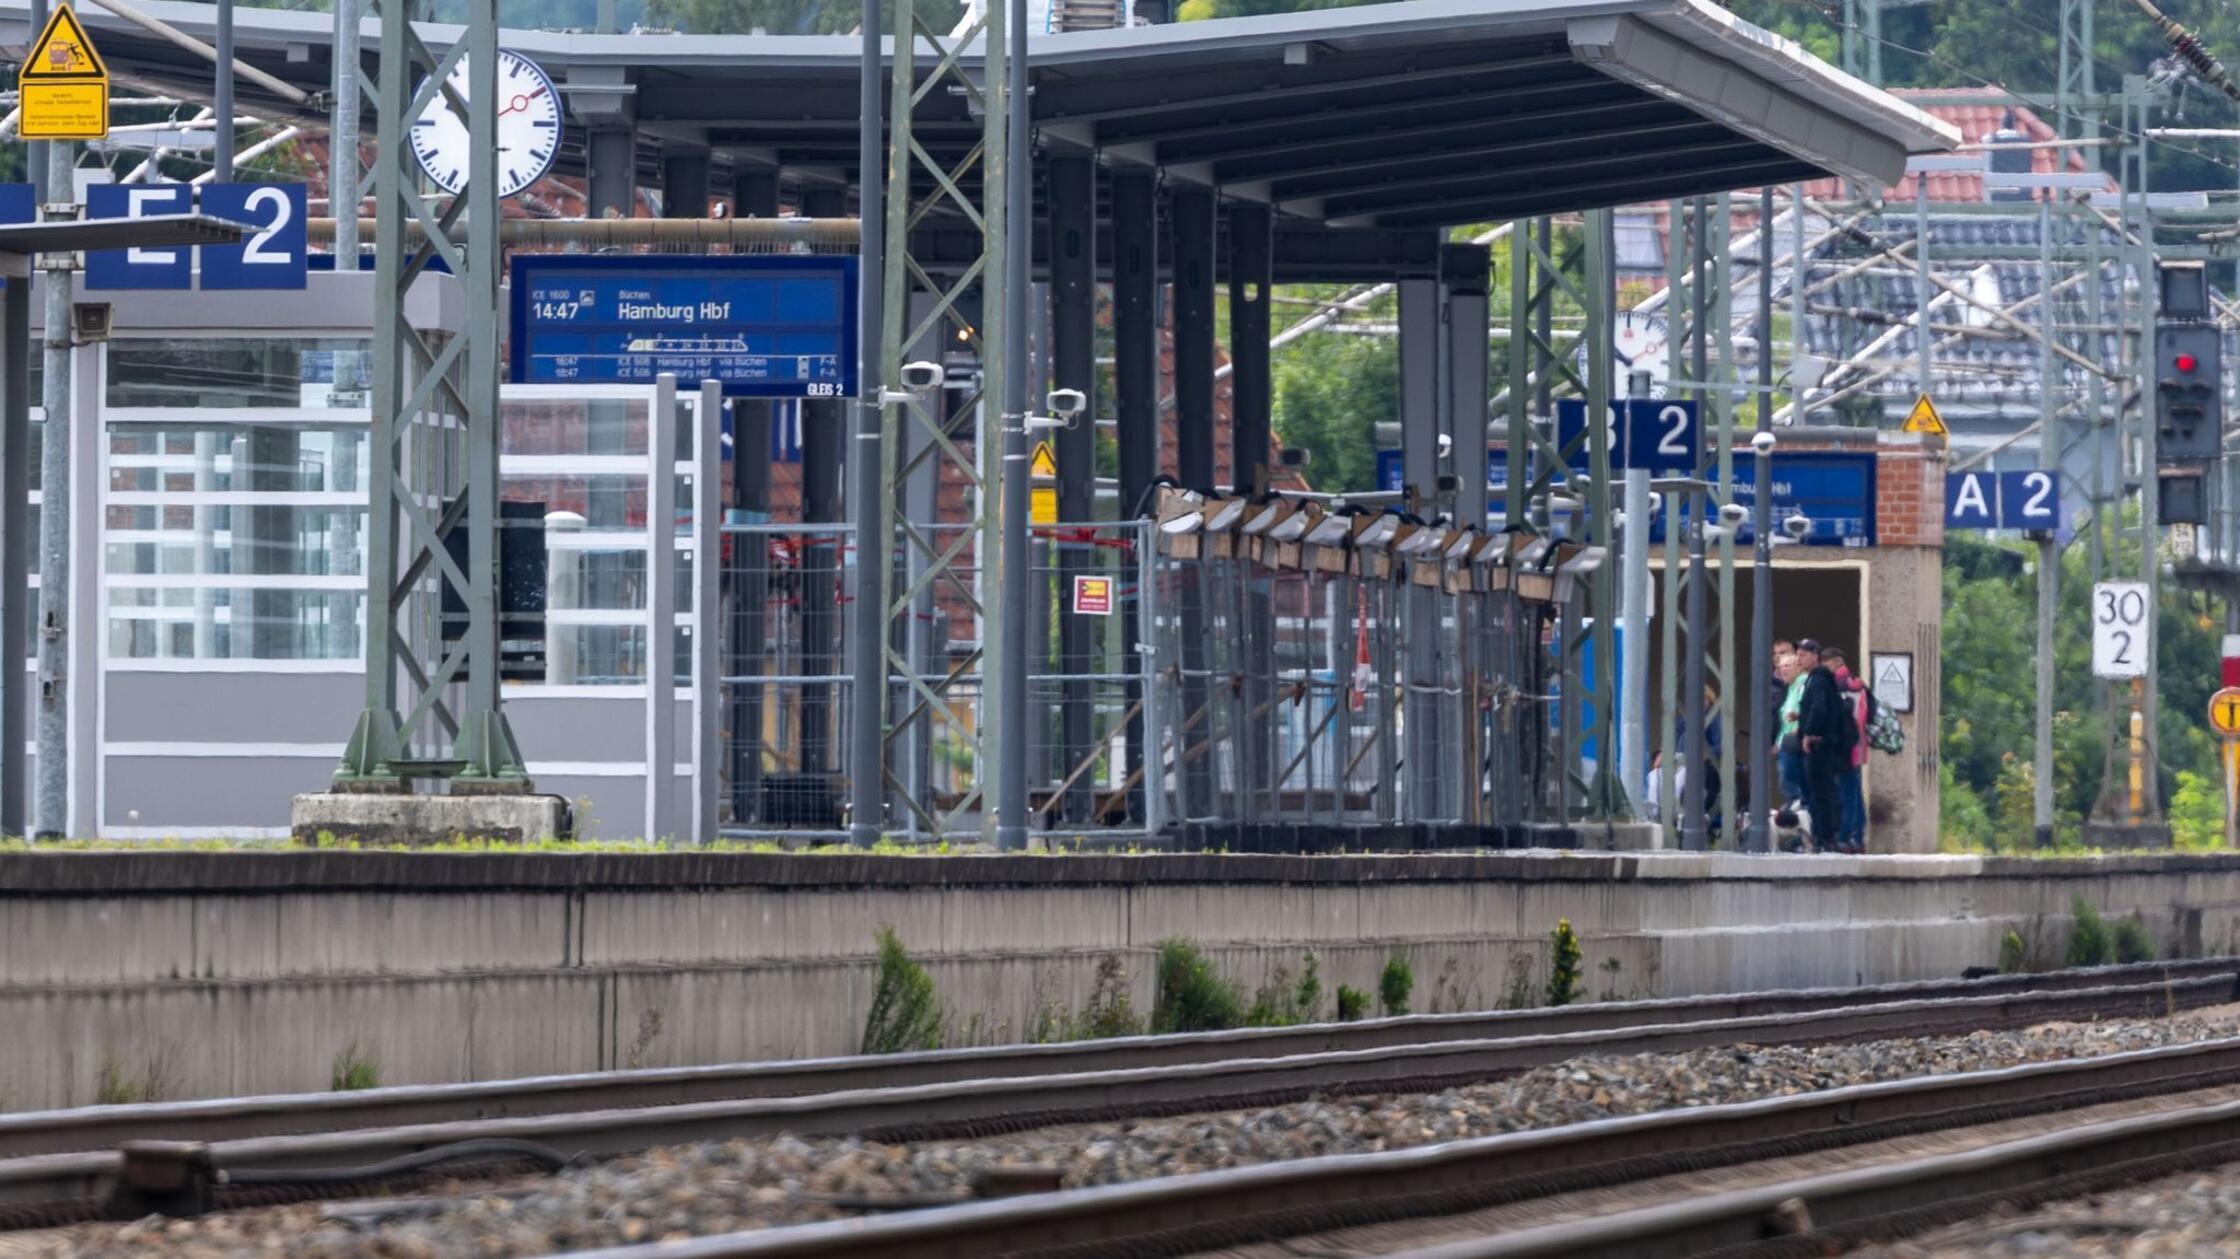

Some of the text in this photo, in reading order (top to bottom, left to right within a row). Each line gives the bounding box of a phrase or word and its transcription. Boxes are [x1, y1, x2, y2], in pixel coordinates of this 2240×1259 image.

[127, 187, 291, 263] E 2
[533, 302, 731, 322] 14:47 Hamburg Hbf
[657, 357, 694, 368] Hamburg
[720, 357, 732, 366] via
[720, 368, 732, 377] via
[735, 367, 767, 377] Büchen
[807, 383, 843, 396] GLEIS 2
[1658, 405, 1688, 454] 2
[1953, 472, 2051, 517] A 2
[2099, 590, 2144, 625] 30
[2111, 631, 2131, 664] 2
